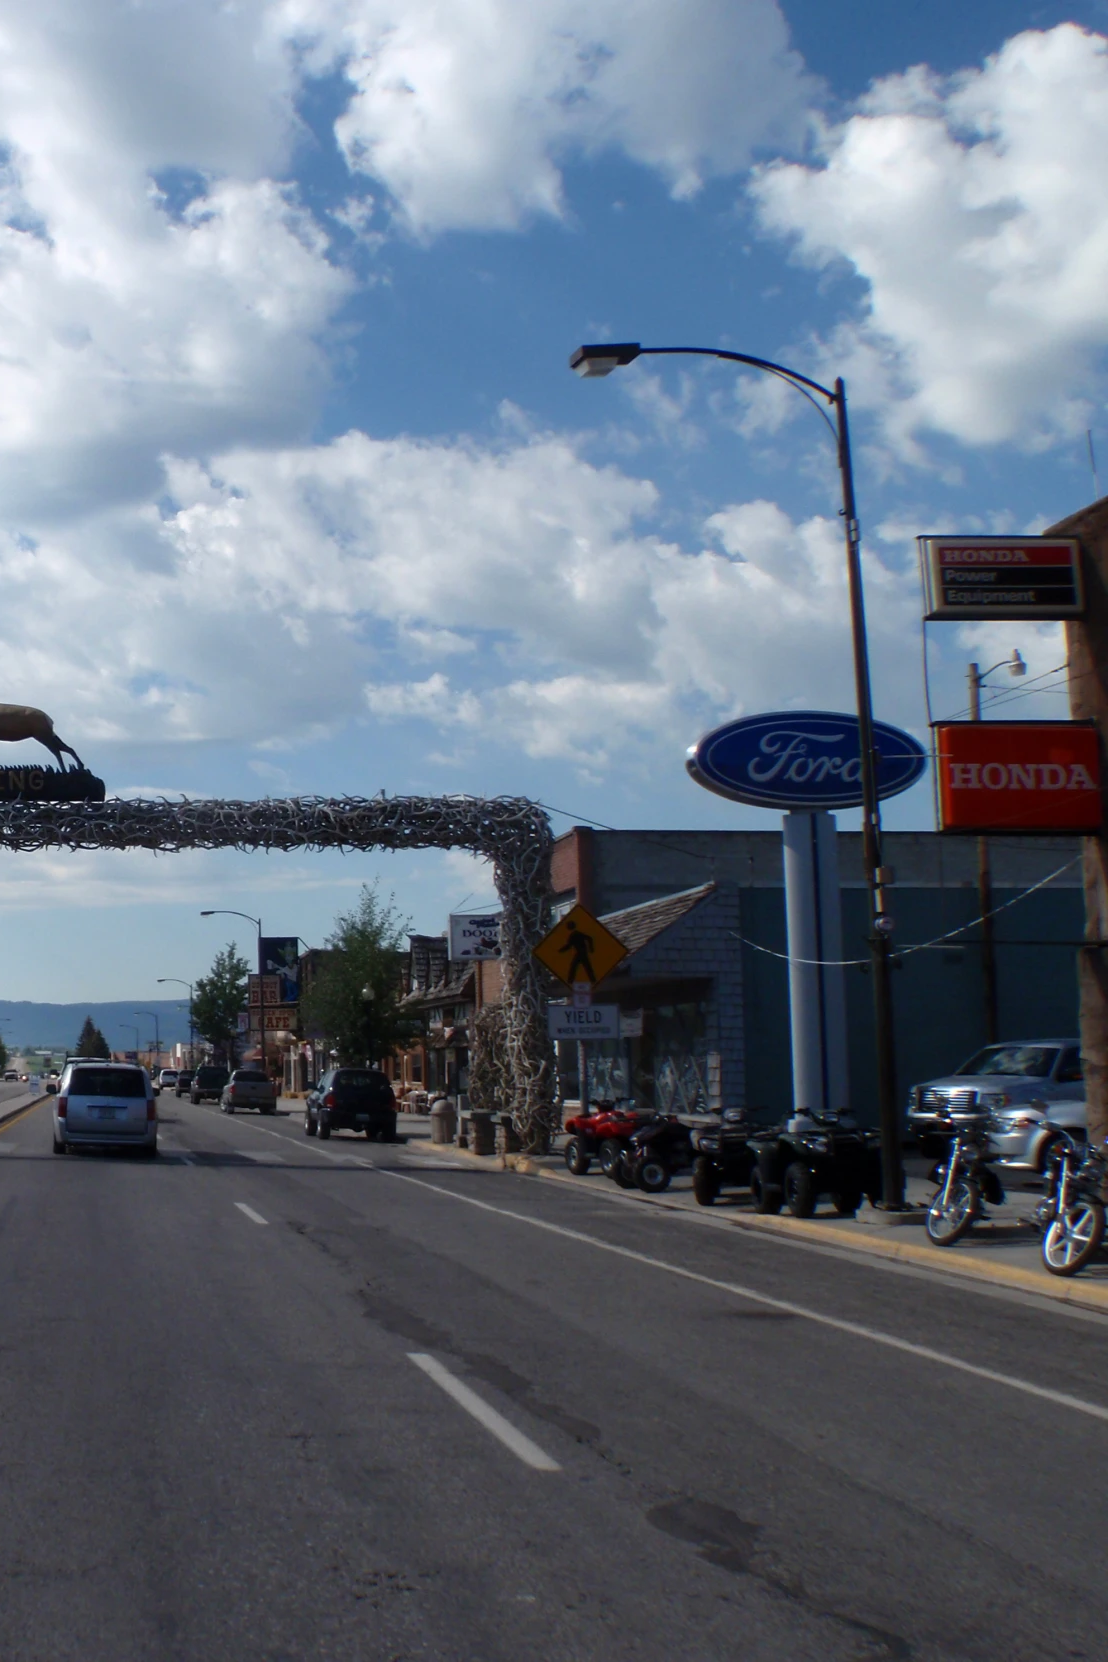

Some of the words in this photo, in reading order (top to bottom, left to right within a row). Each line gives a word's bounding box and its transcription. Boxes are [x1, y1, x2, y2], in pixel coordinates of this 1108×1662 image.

[943, 550, 1030, 563] HONDA
[945, 569, 996, 582] Power
[947, 589, 1036, 604] Equipment
[950, 763, 1097, 790] HONDA
[564, 1010, 602, 1024] YIELD
